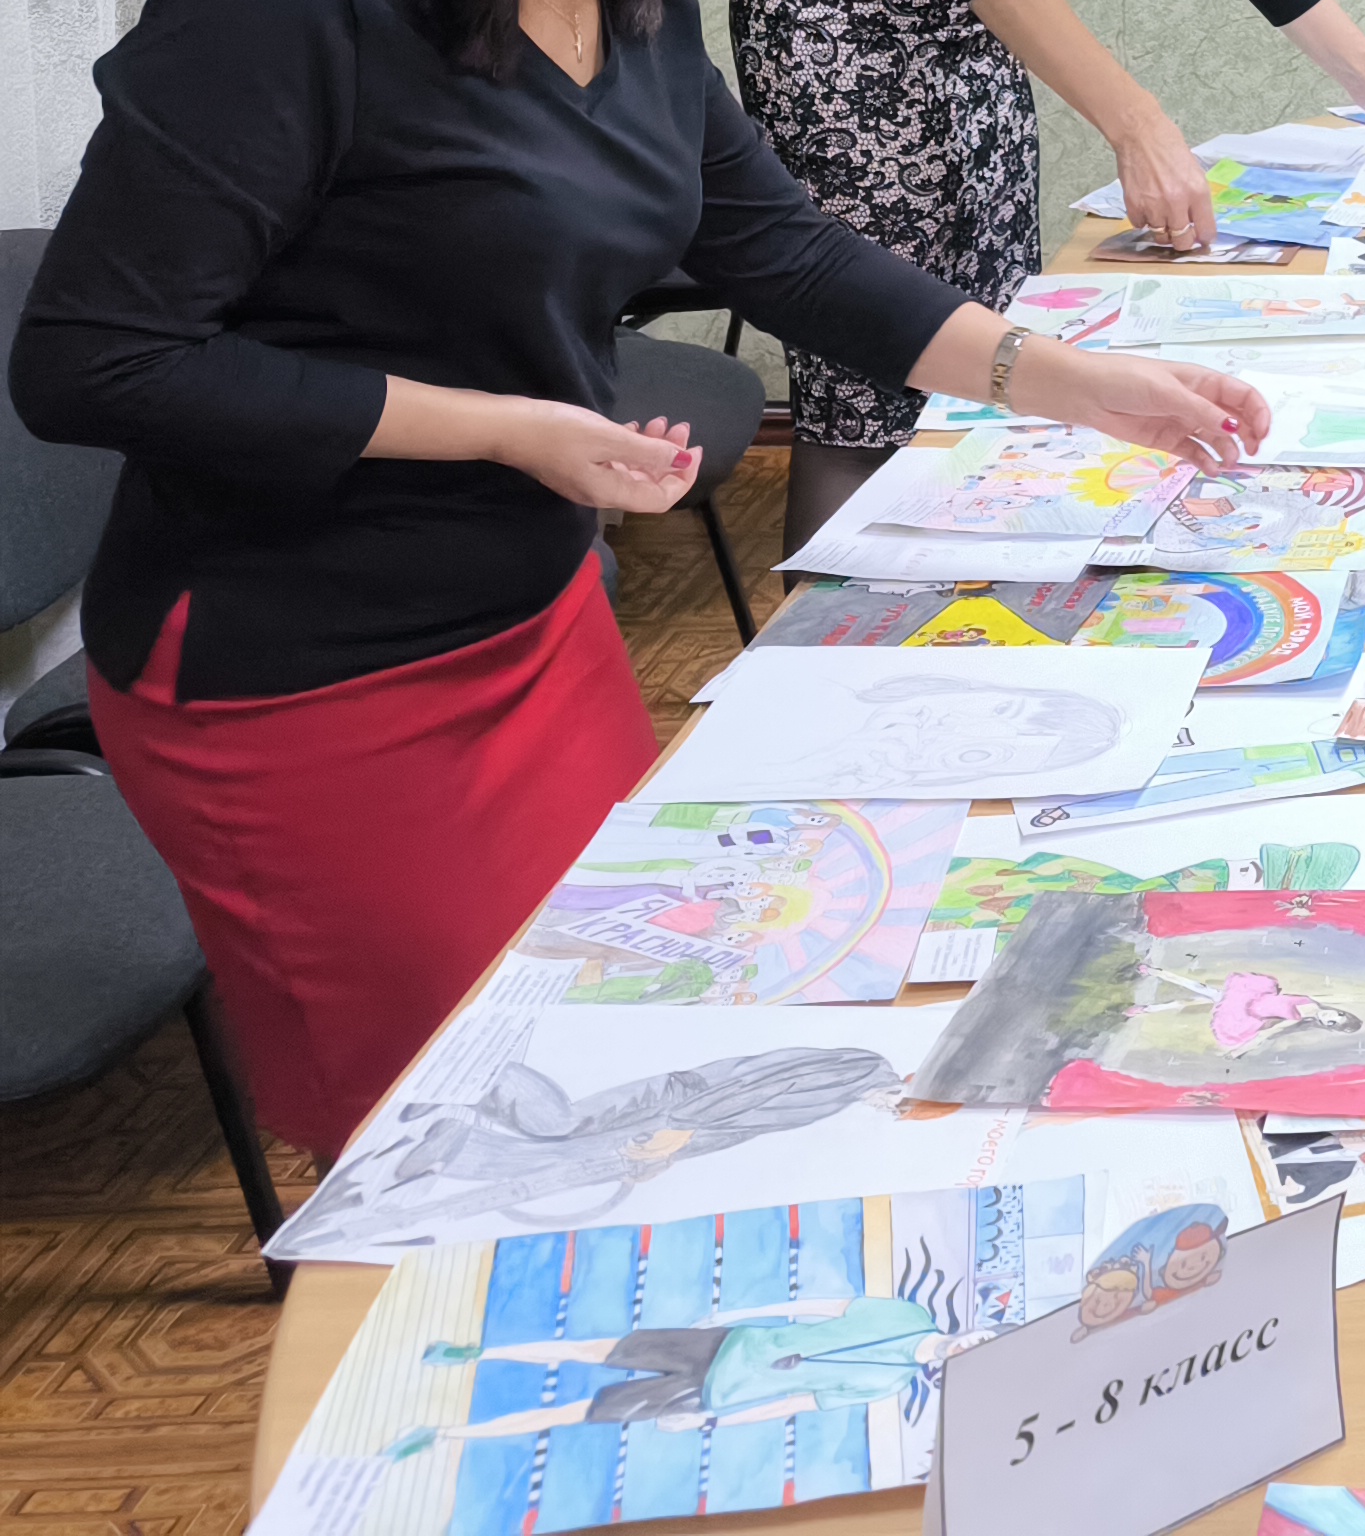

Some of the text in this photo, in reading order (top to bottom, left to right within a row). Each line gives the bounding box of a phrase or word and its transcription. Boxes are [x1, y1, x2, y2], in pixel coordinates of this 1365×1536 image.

[617, 898, 673, 920] Я
[1009, 1412, 1040, 1466] 5
[1095, 1378, 1124, 1425] 8
[1139, 1316, 1279, 1407] класс
